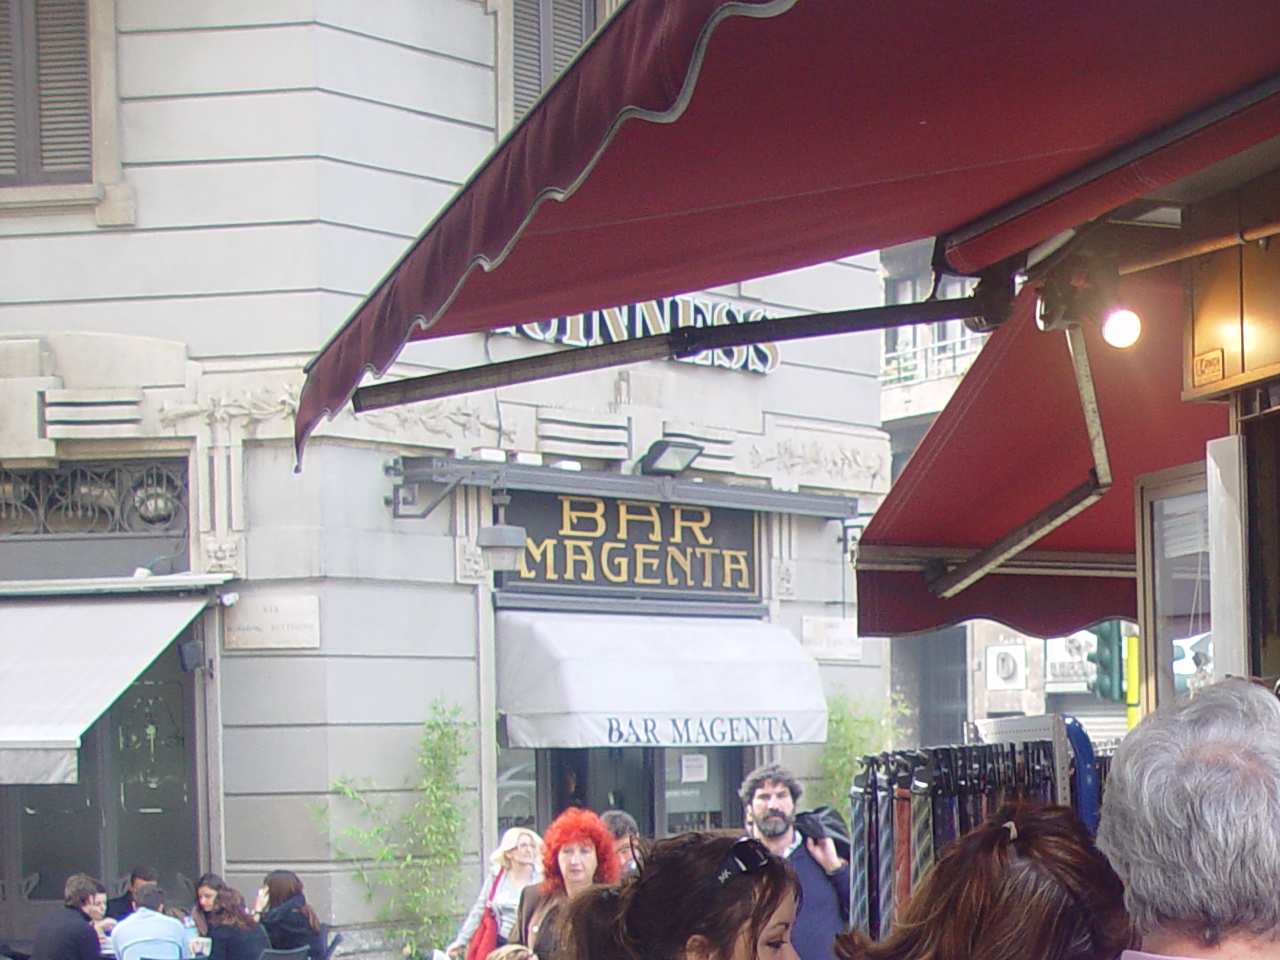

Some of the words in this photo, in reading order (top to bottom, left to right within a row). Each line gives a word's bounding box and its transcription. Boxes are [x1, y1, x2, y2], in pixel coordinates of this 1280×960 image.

[496, 296, 781, 375] INNESS
[557, 494, 713, 545] BAR
[519, 537, 750, 589] MAGENTA
[606, 717, 661, 744] BAR
[670, 716, 794, 744] MAGENTA
